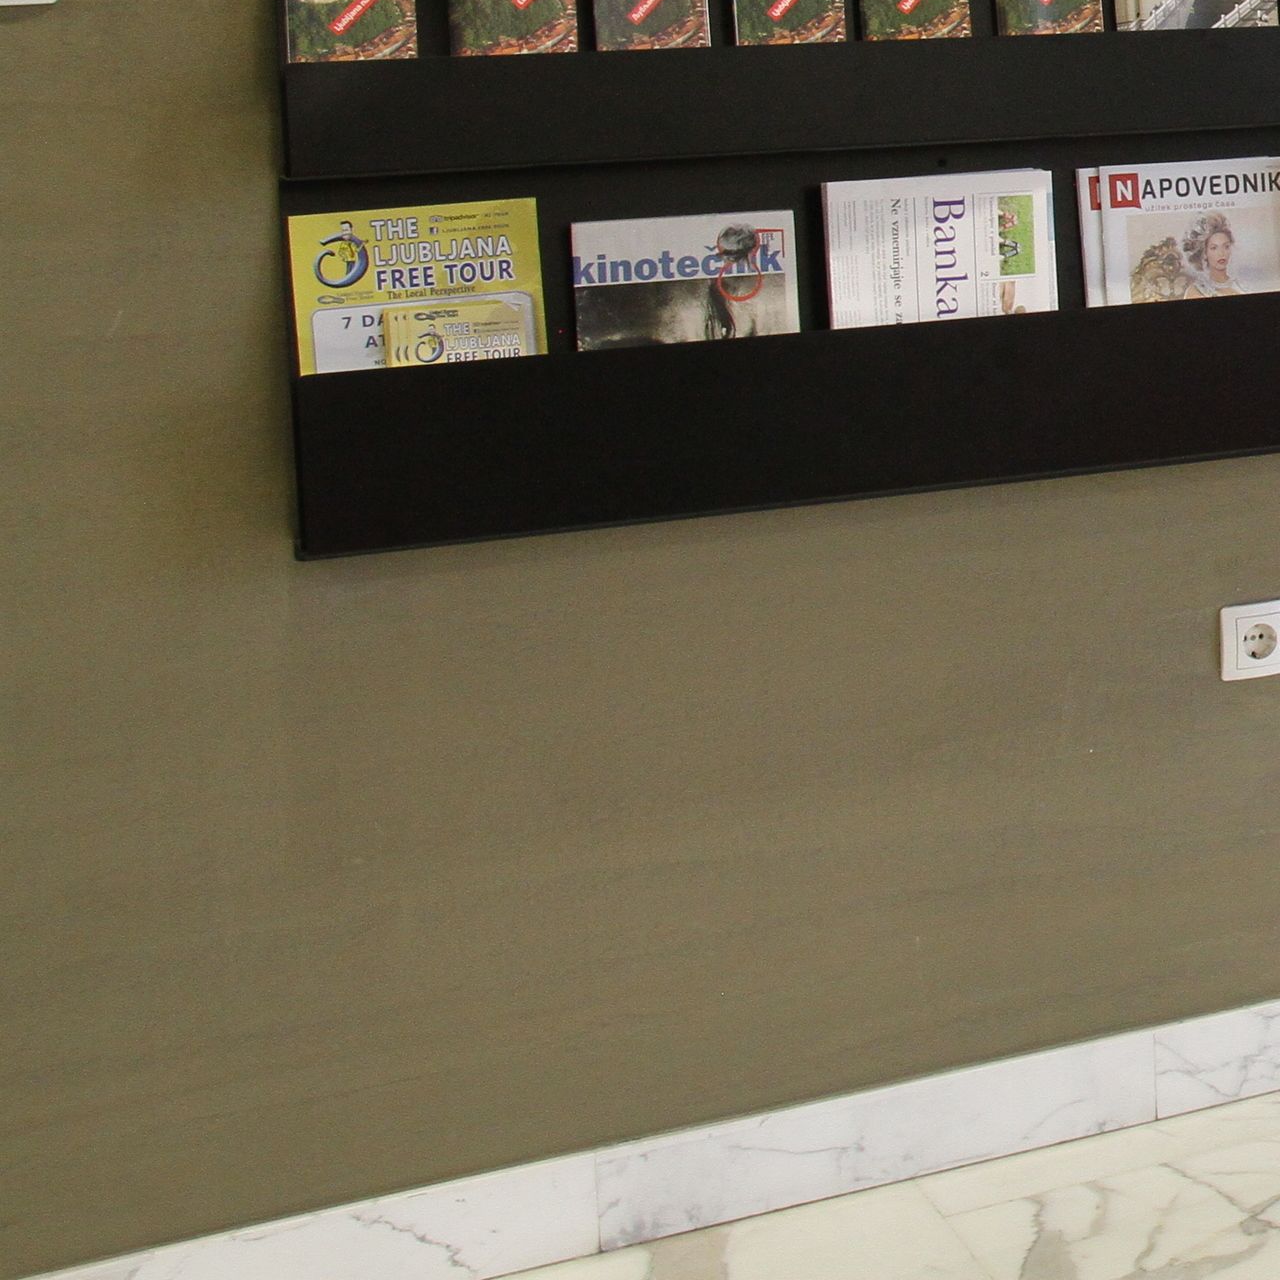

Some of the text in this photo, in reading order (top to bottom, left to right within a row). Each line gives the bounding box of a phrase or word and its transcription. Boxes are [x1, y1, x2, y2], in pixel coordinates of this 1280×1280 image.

[334, 3, 363, 32] Ljubljana
[889, 198, 902, 215] Ne
[1145, 199, 1236, 212] užitek prostega časa
[371, 215, 419, 241] THE
[373, 234, 512, 267] LJUBLJANA
[932, 197, 969, 319] Banka
[376, 259, 515, 291] FREE TOUR
[387, 285, 476, 300] The Local Perspective
[341, 317, 352, 330] 7
[444, 323, 470, 336] THE
[445, 335, 520, 351] LJUBLJANA
[447, 348, 521, 363] FREE TOUR
